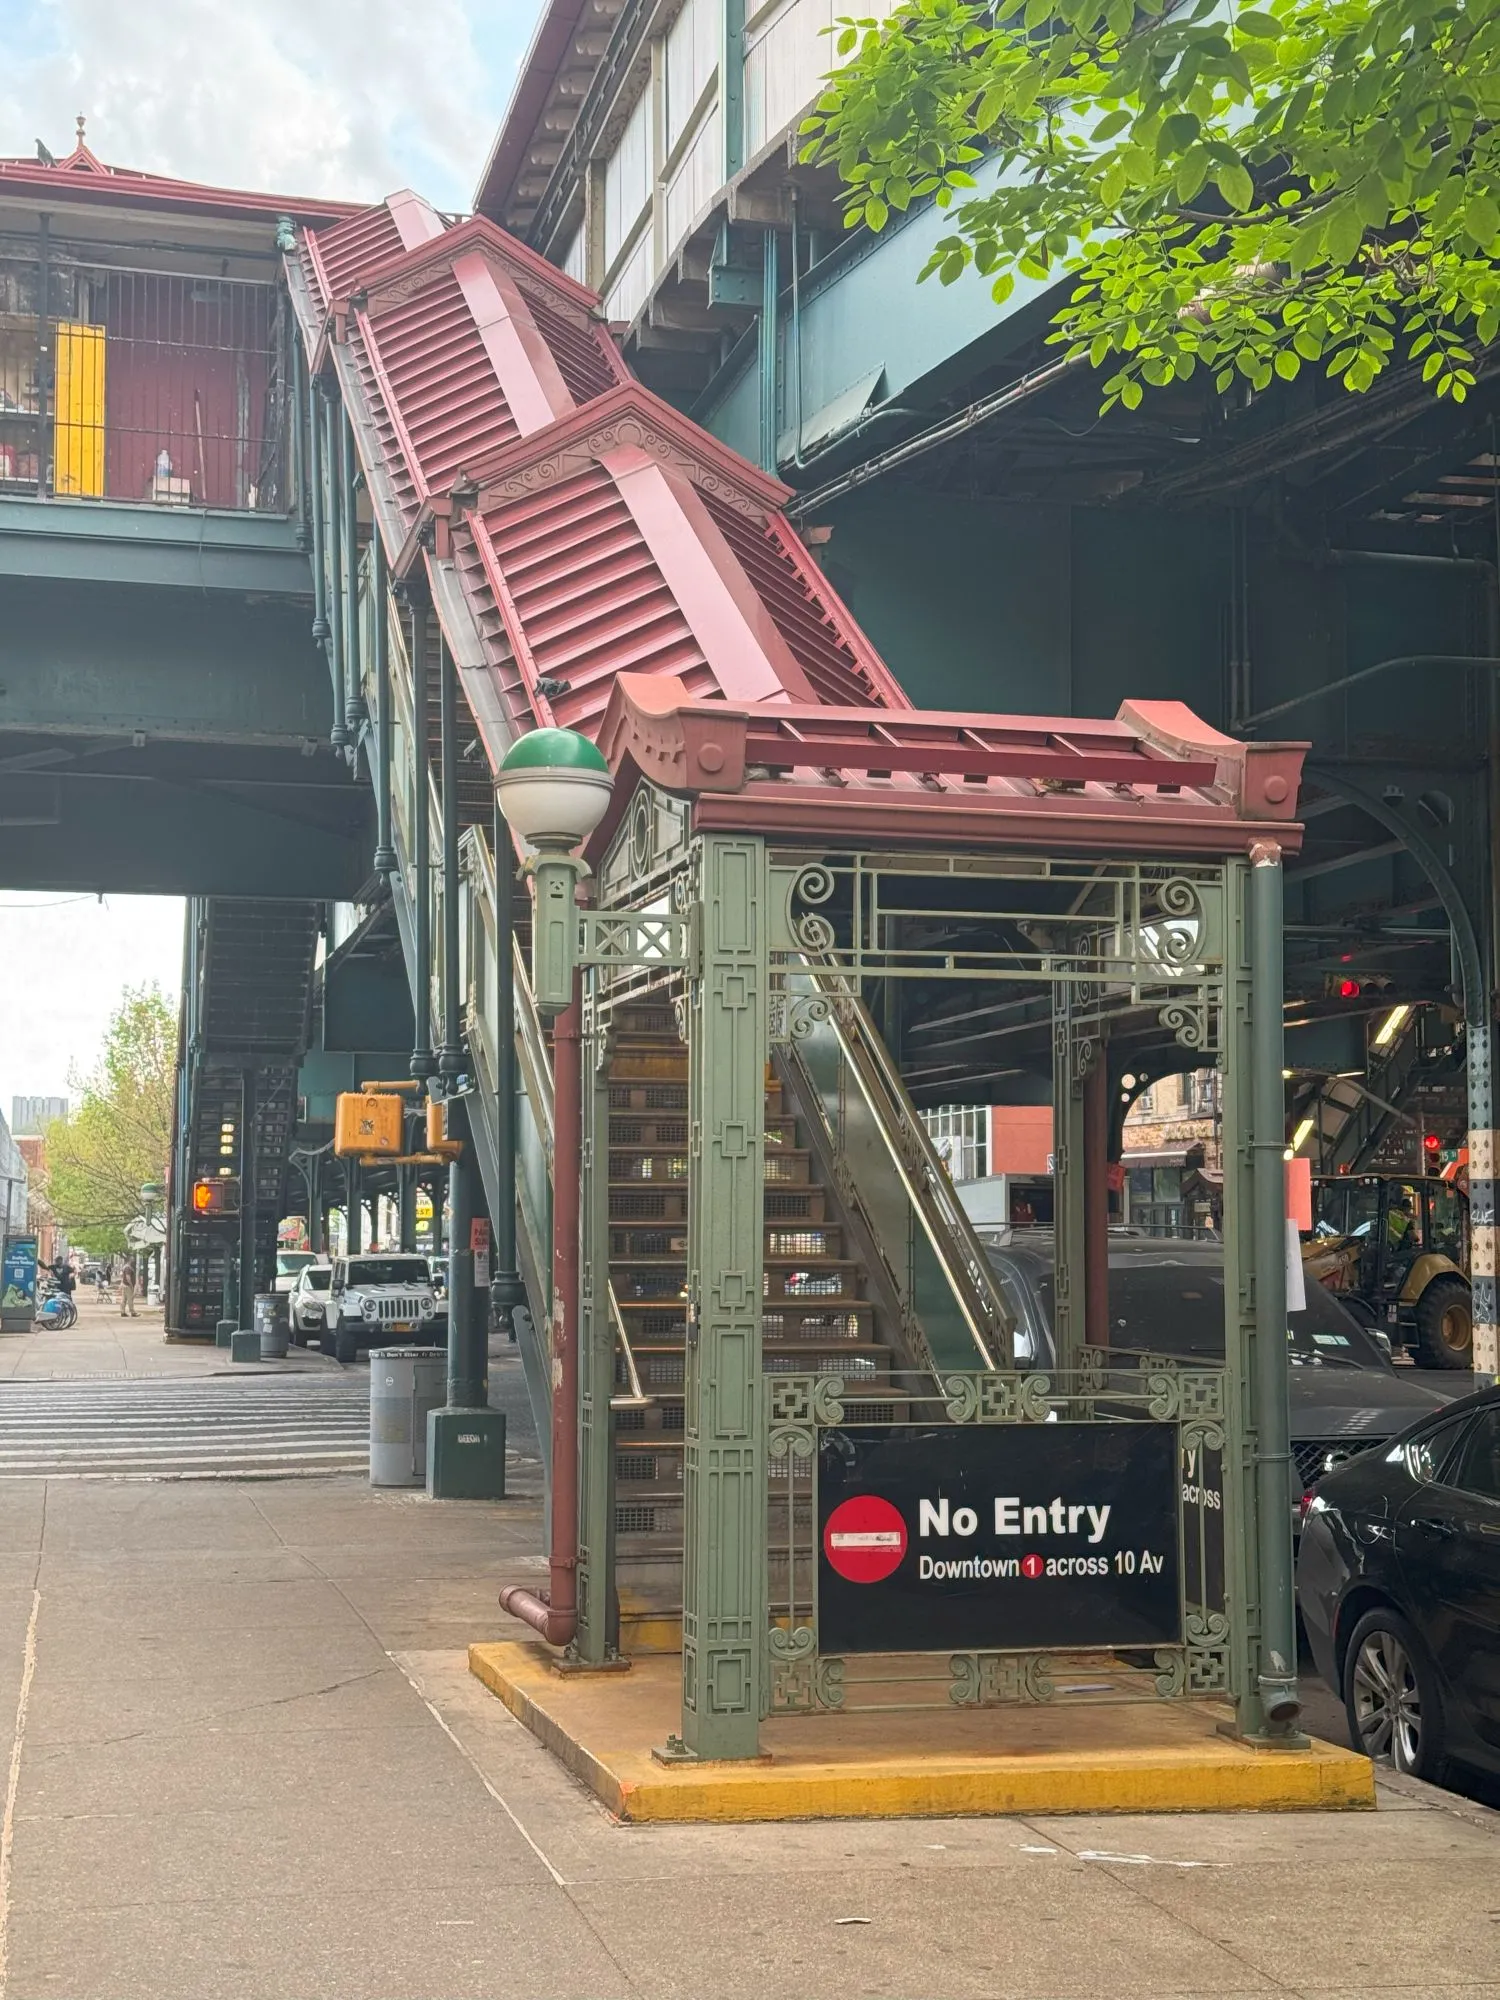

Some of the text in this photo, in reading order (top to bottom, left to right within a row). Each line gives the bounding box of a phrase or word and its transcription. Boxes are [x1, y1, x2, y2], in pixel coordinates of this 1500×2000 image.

[919, 1496, 1111, 1544] No Entry
[919, 1550, 1164, 1580] Downtown 1 across 10 Av
